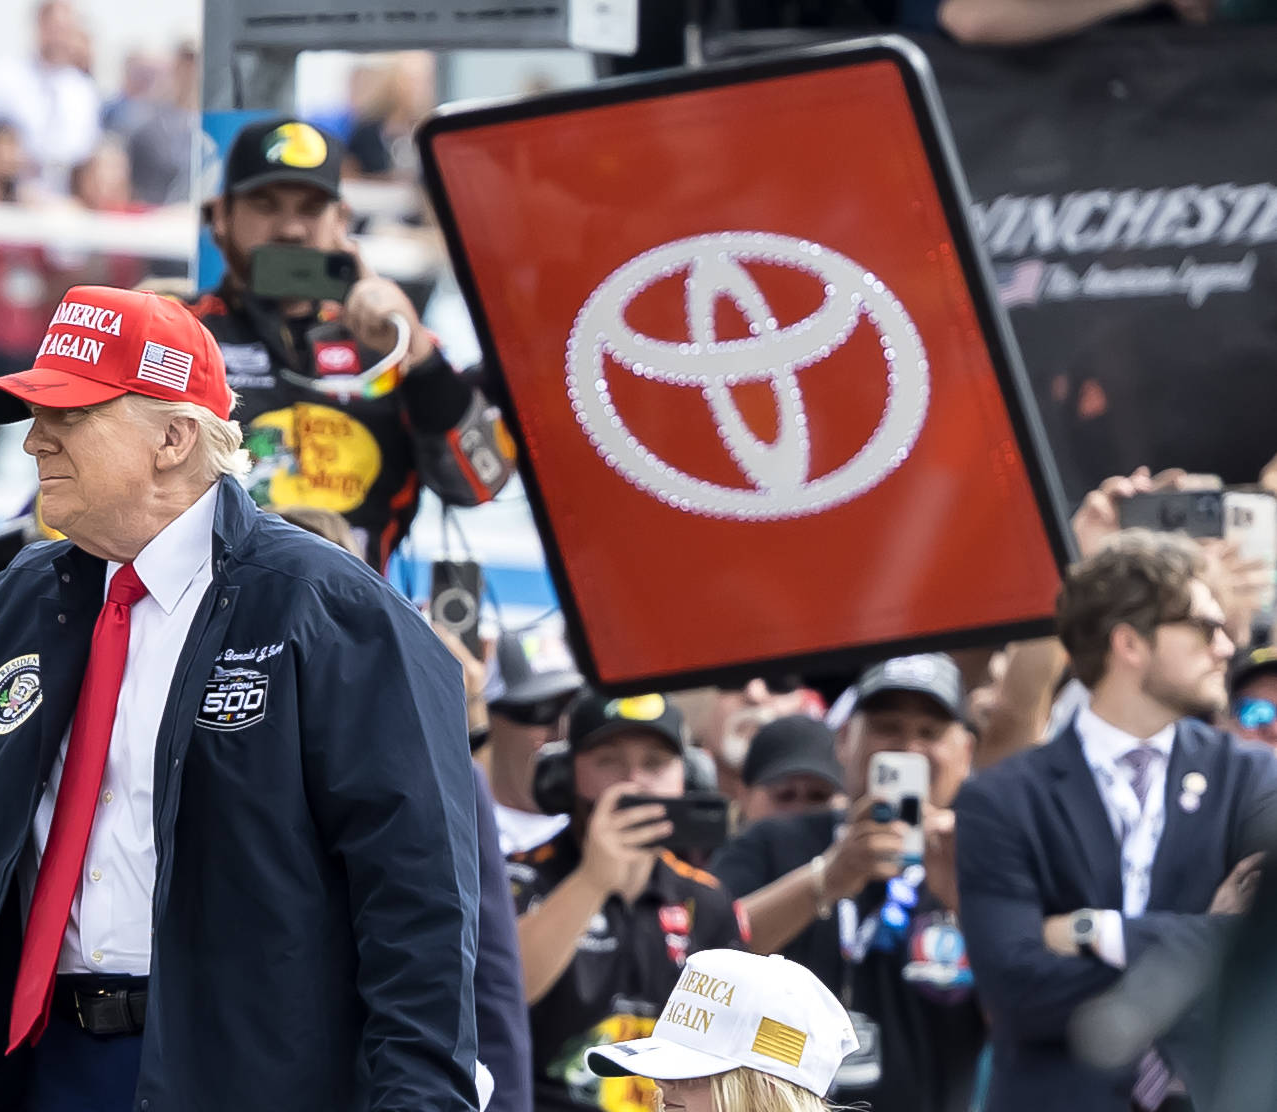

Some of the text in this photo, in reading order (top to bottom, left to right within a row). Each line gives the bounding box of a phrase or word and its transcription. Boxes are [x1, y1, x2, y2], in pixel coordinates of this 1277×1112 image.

[46, 333, 105, 366] AGAIN
[203, 689, 264, 712] 500
[218, 682, 254, 691] DAYTONA
[665, 1001, 715, 1034] AGAIN
